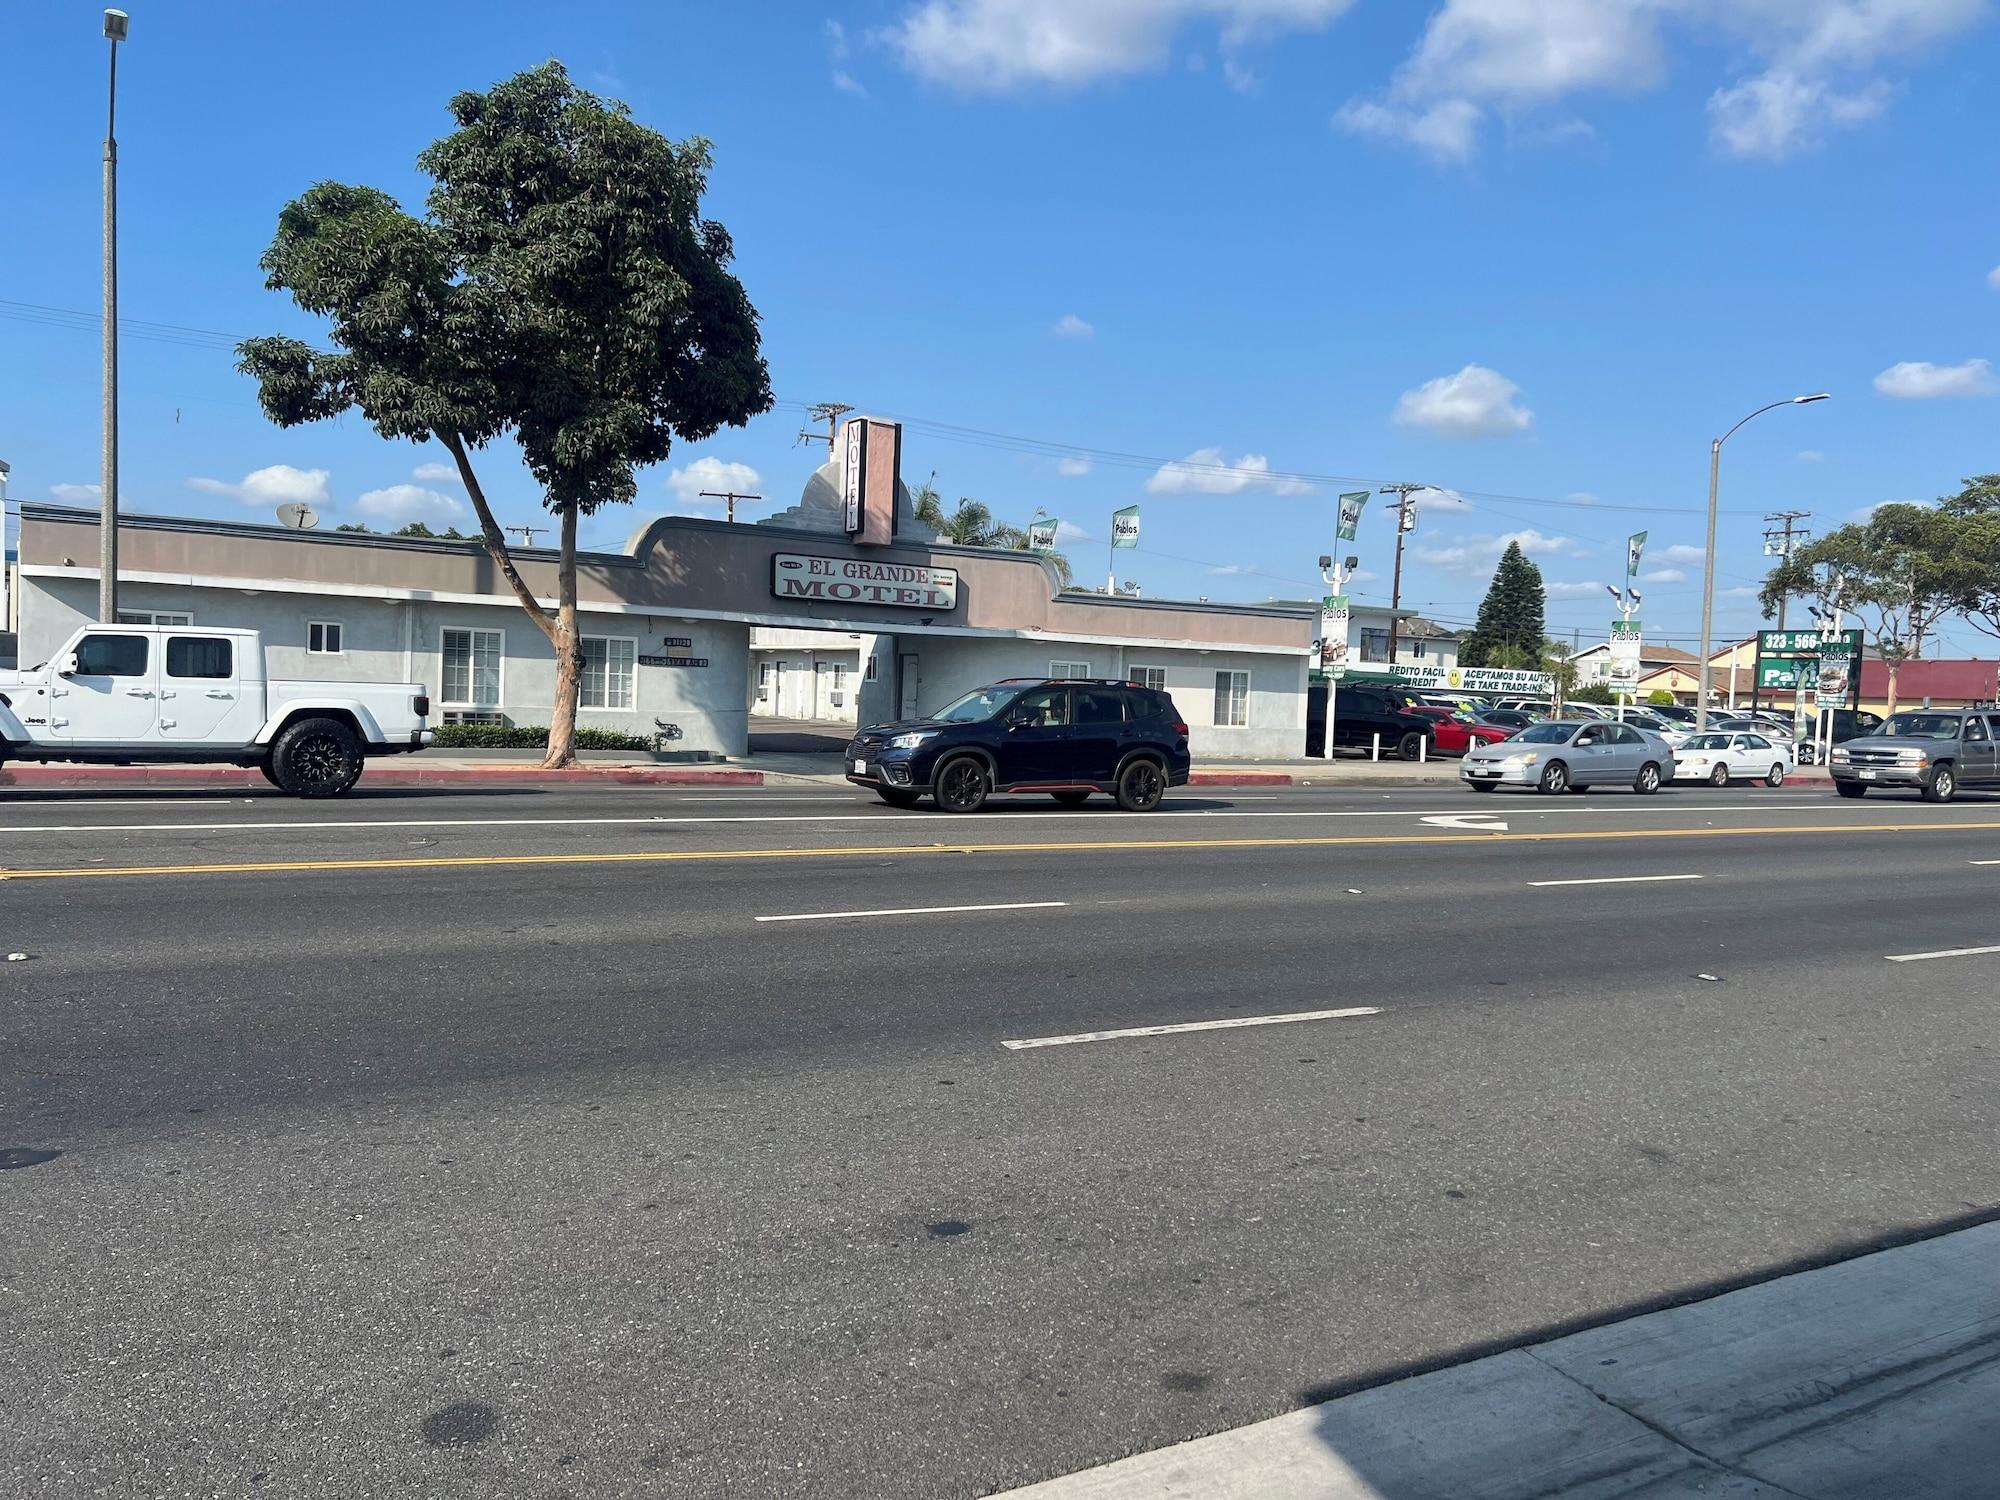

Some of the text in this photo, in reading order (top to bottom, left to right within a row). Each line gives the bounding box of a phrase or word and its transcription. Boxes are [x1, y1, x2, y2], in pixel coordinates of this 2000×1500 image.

[849, 425, 860, 528] MOTEL
[1116, 523, 1138, 534] Pablos
[1033, 534, 1053, 545] Pablos
[808, 559, 928, 584] EL GRANDE
[782, 578, 949, 607] MOTEL
[1322, 606, 1347, 619] Pablos
[1611, 630, 1640, 641] Pablos
[1765, 634, 1786, 648] 323
[1821, 651, 1849, 661] Pablos
[1464, 670, 1514, 680] ACEPTAMOS
[1515, 673, 1527, 681] SU
[1463, 680, 1475, 689] WE
[1478, 681, 1499, 690] TAKE
